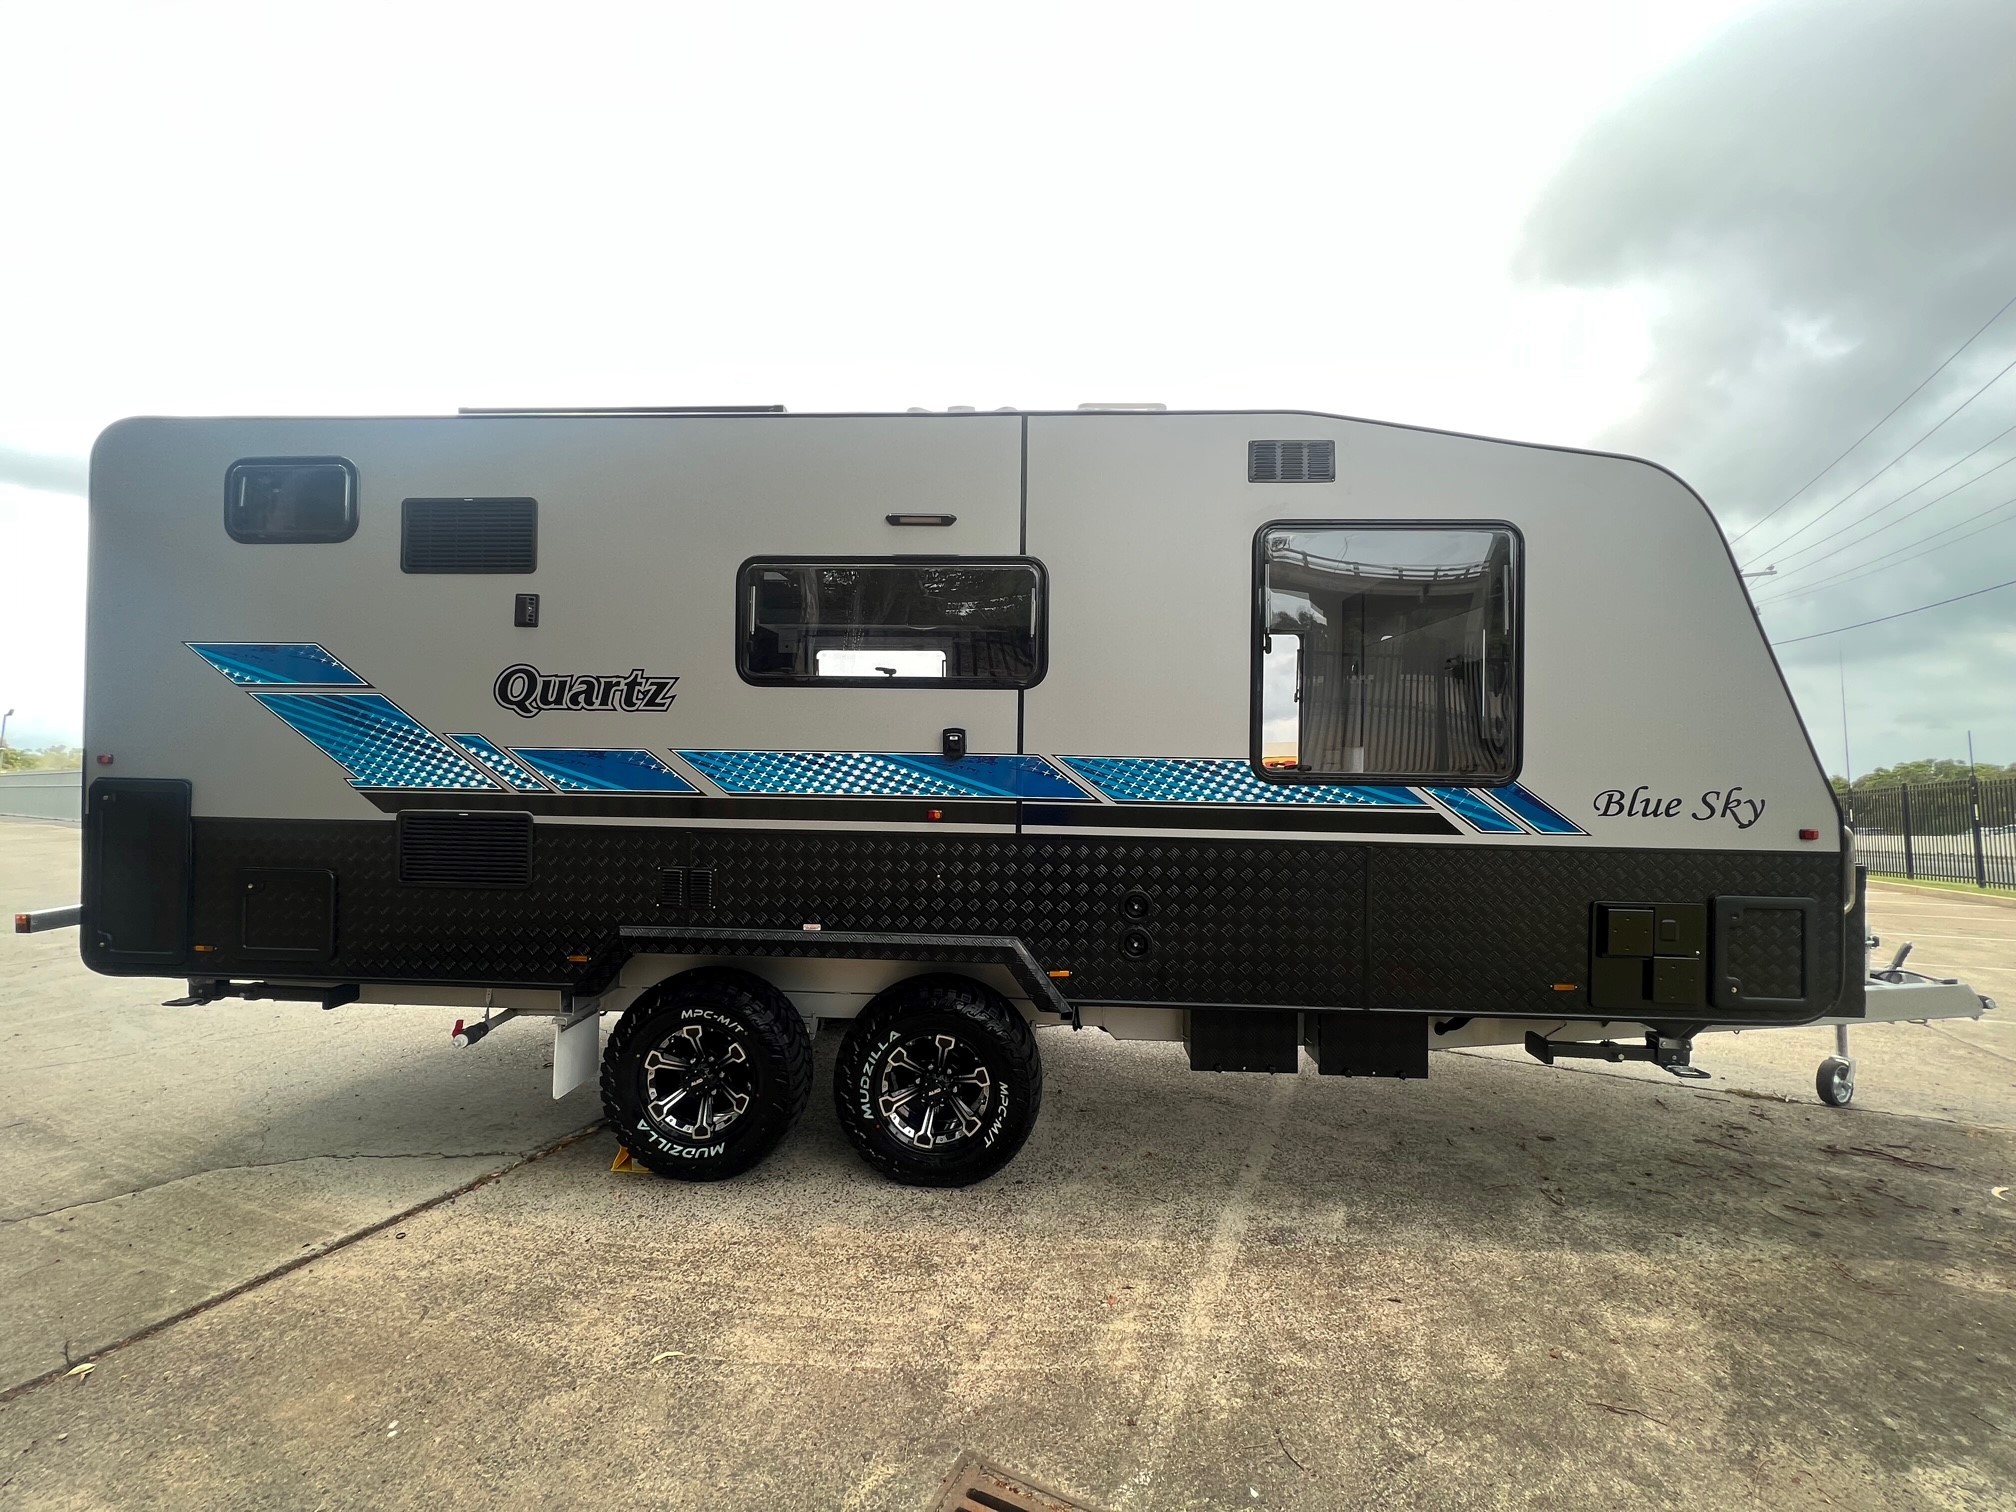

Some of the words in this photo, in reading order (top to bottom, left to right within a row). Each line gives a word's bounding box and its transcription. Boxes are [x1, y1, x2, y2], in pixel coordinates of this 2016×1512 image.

[493, 663, 681, 719] Quartz
[1593, 785, 1683, 818] Blue
[1691, 786, 1766, 830] Sky
[681, 1009, 744, 1033] MPC-M/T
[859, 1030, 901, 1120] MUDZILLA
[636, 1118, 726, 1159] MUDZILLA
[983, 1081, 1009, 1149] MPC-M/T
